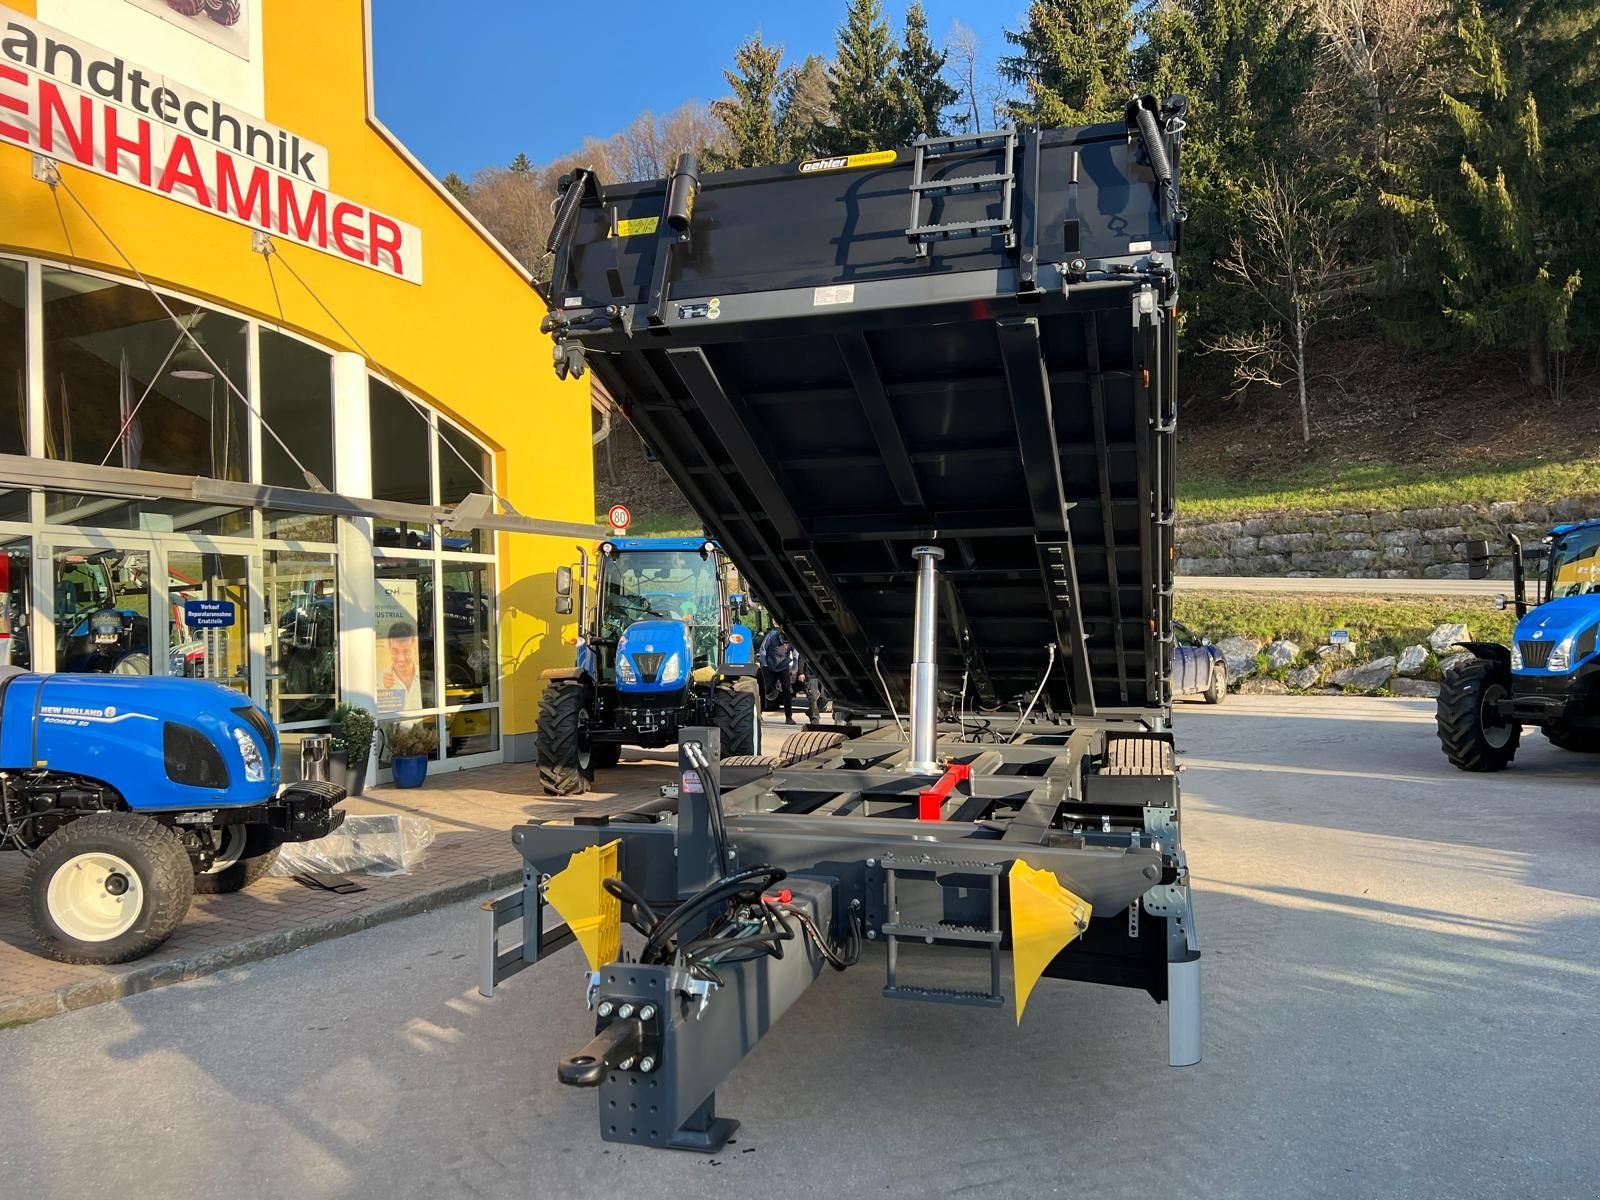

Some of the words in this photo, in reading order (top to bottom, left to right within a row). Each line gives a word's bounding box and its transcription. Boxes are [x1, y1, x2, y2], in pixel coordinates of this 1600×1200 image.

[1, 21, 316, 183] andtechnik
[0, 63, 404, 276] ENHAMMER
[802, 157, 847, 171] oehler
[849, 153, 894, 164] FAHRZEUGBAU
[614, 511, 626, 523] 80
[41, 706, 62, 714] NEW
[63, 707, 103, 717] HOLLAND
